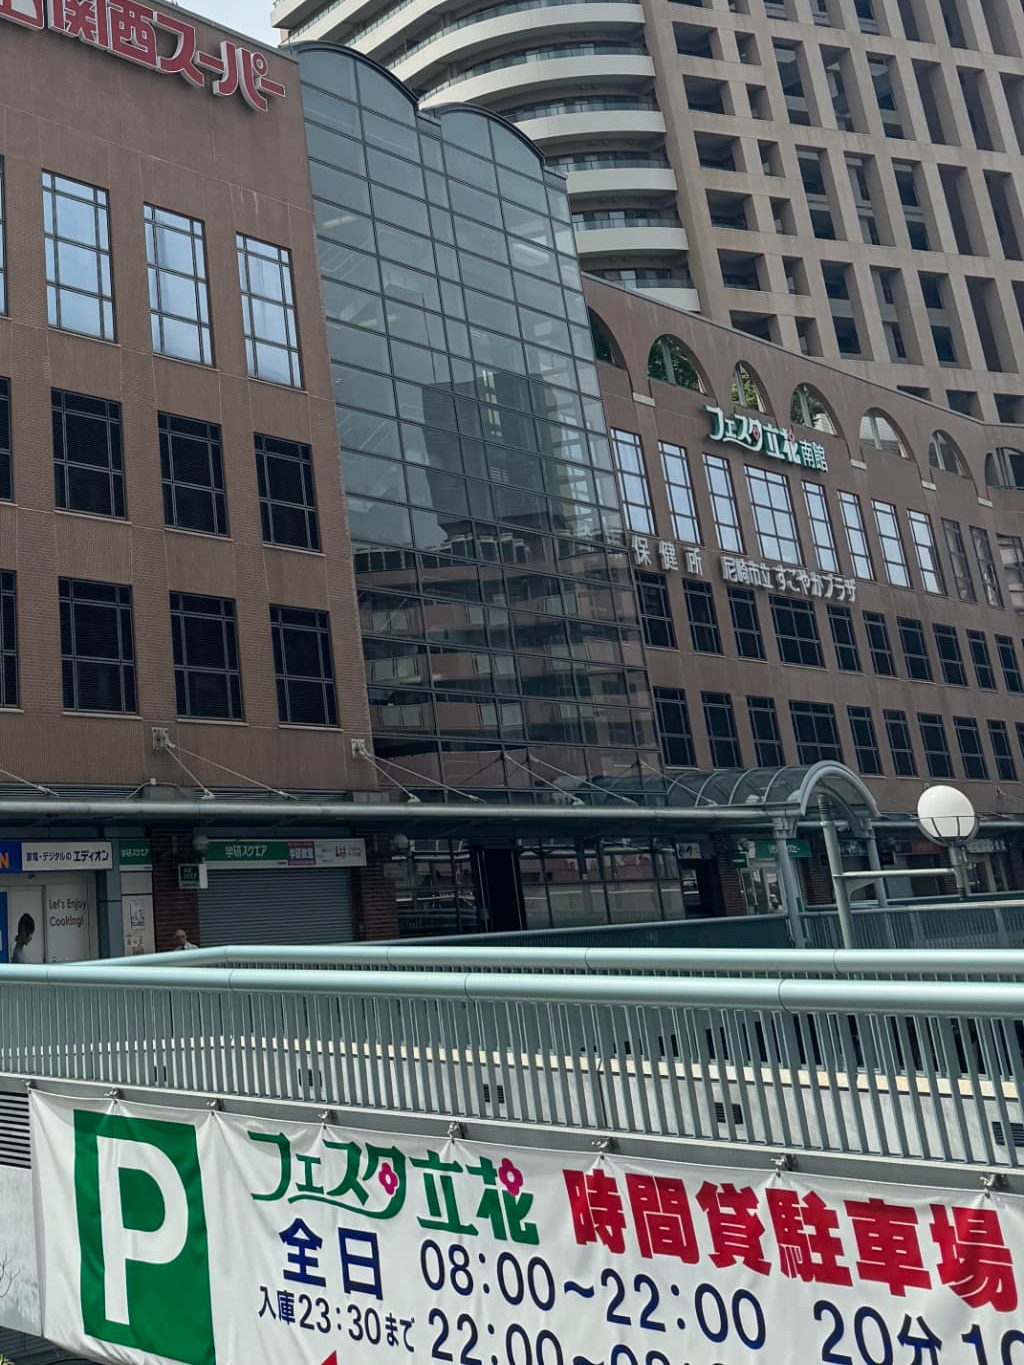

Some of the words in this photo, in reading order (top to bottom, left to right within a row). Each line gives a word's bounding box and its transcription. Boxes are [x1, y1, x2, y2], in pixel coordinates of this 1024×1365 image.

[631, 534, 704, 577] 保健所
[73, 850, 110, 862] エディオン
[48, 898, 65, 910] Let's
[66, 898, 87, 911] Enjoy
[96, 1135, 189, 1326] P
[247, 1129, 540, 1245] フェスタ立花
[562, 1168, 1018, 1313] 時間貸駐車場
[278, 1217, 384, 1301] 全日
[258, 1285, 415, 1353] 入庫23:30まで
